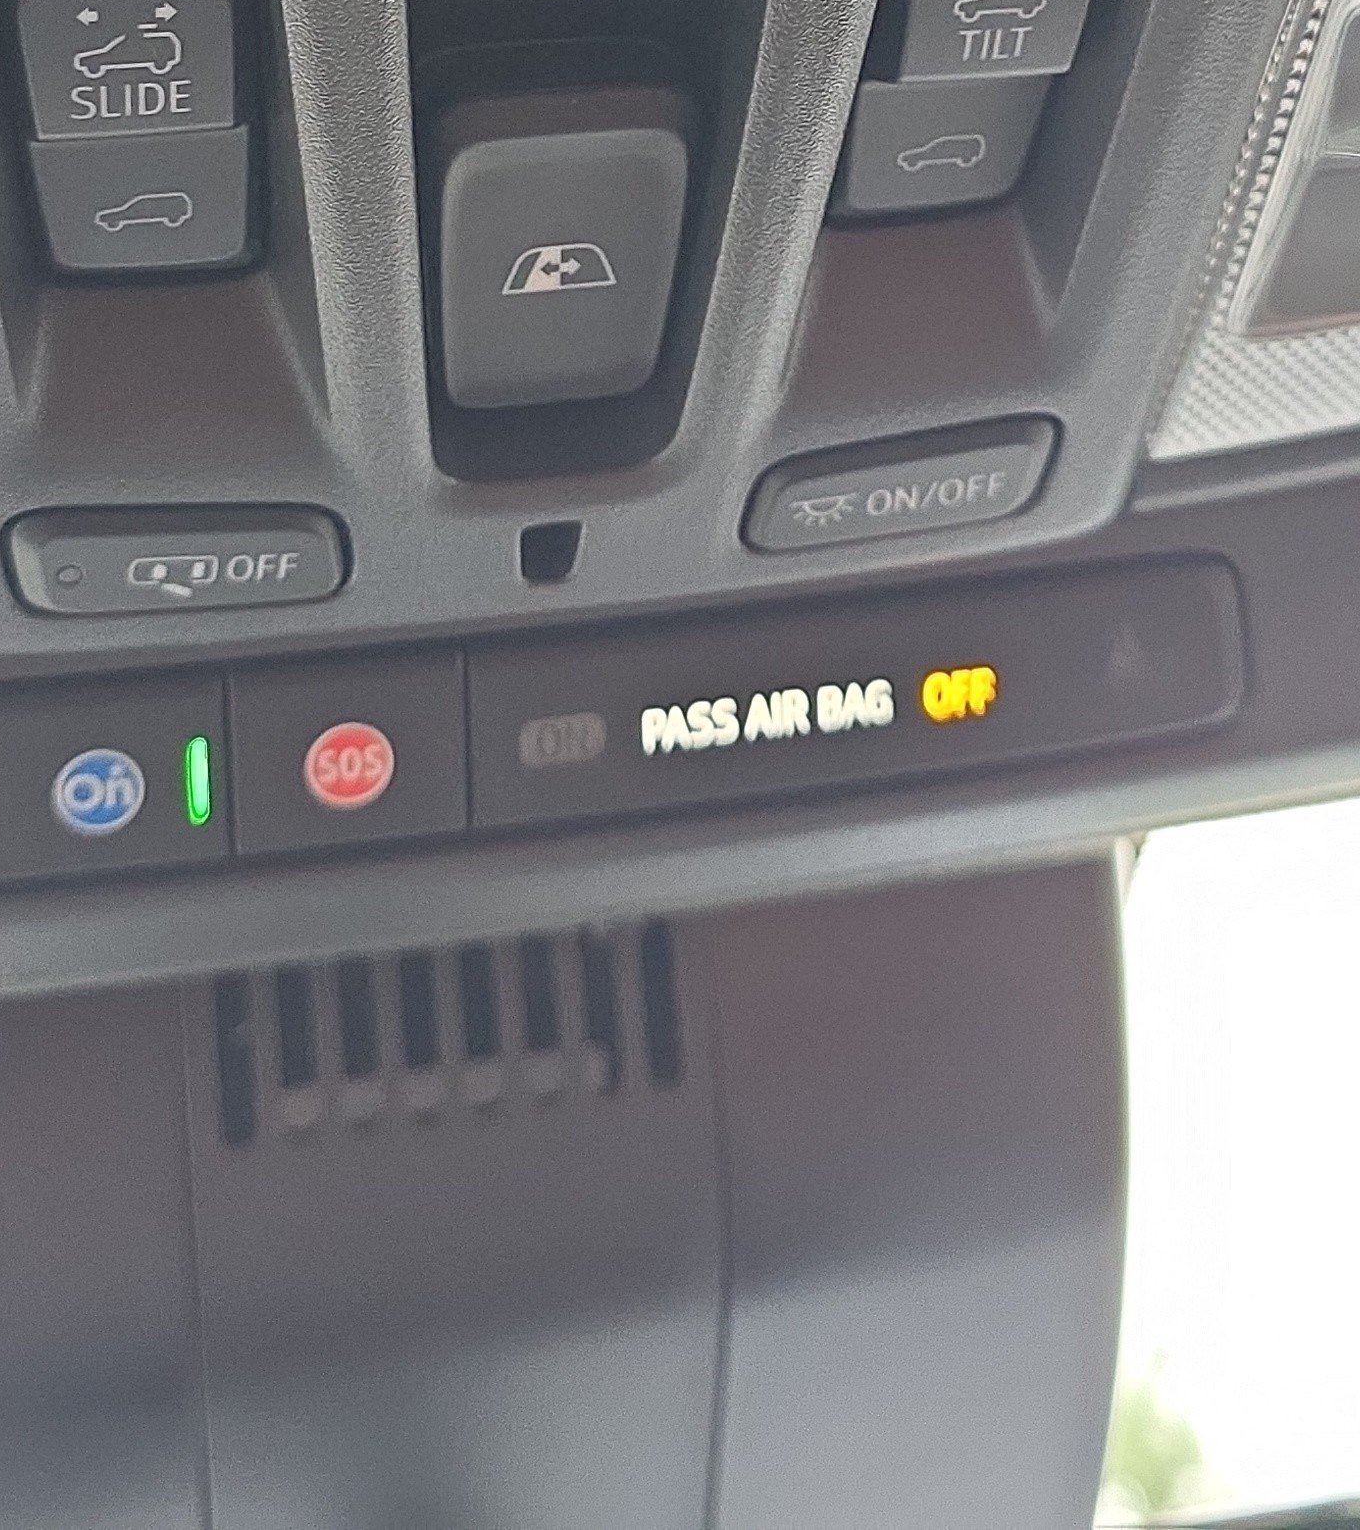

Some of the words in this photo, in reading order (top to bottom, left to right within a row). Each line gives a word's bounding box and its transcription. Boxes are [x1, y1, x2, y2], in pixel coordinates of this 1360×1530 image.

[958, 26, 1033, 62] TILT
[70, 80, 192, 120] SLIDE
[866, 472, 1007, 516] ON/OFF
[226, 553, 300, 582] OFF
[642, 697, 740, 755] PASS
[744, 688, 811, 741] AIR
[817, 678, 894, 733] BAG
[922, 666, 998, 721] OFF
[315, 744, 383, 784] SOS
